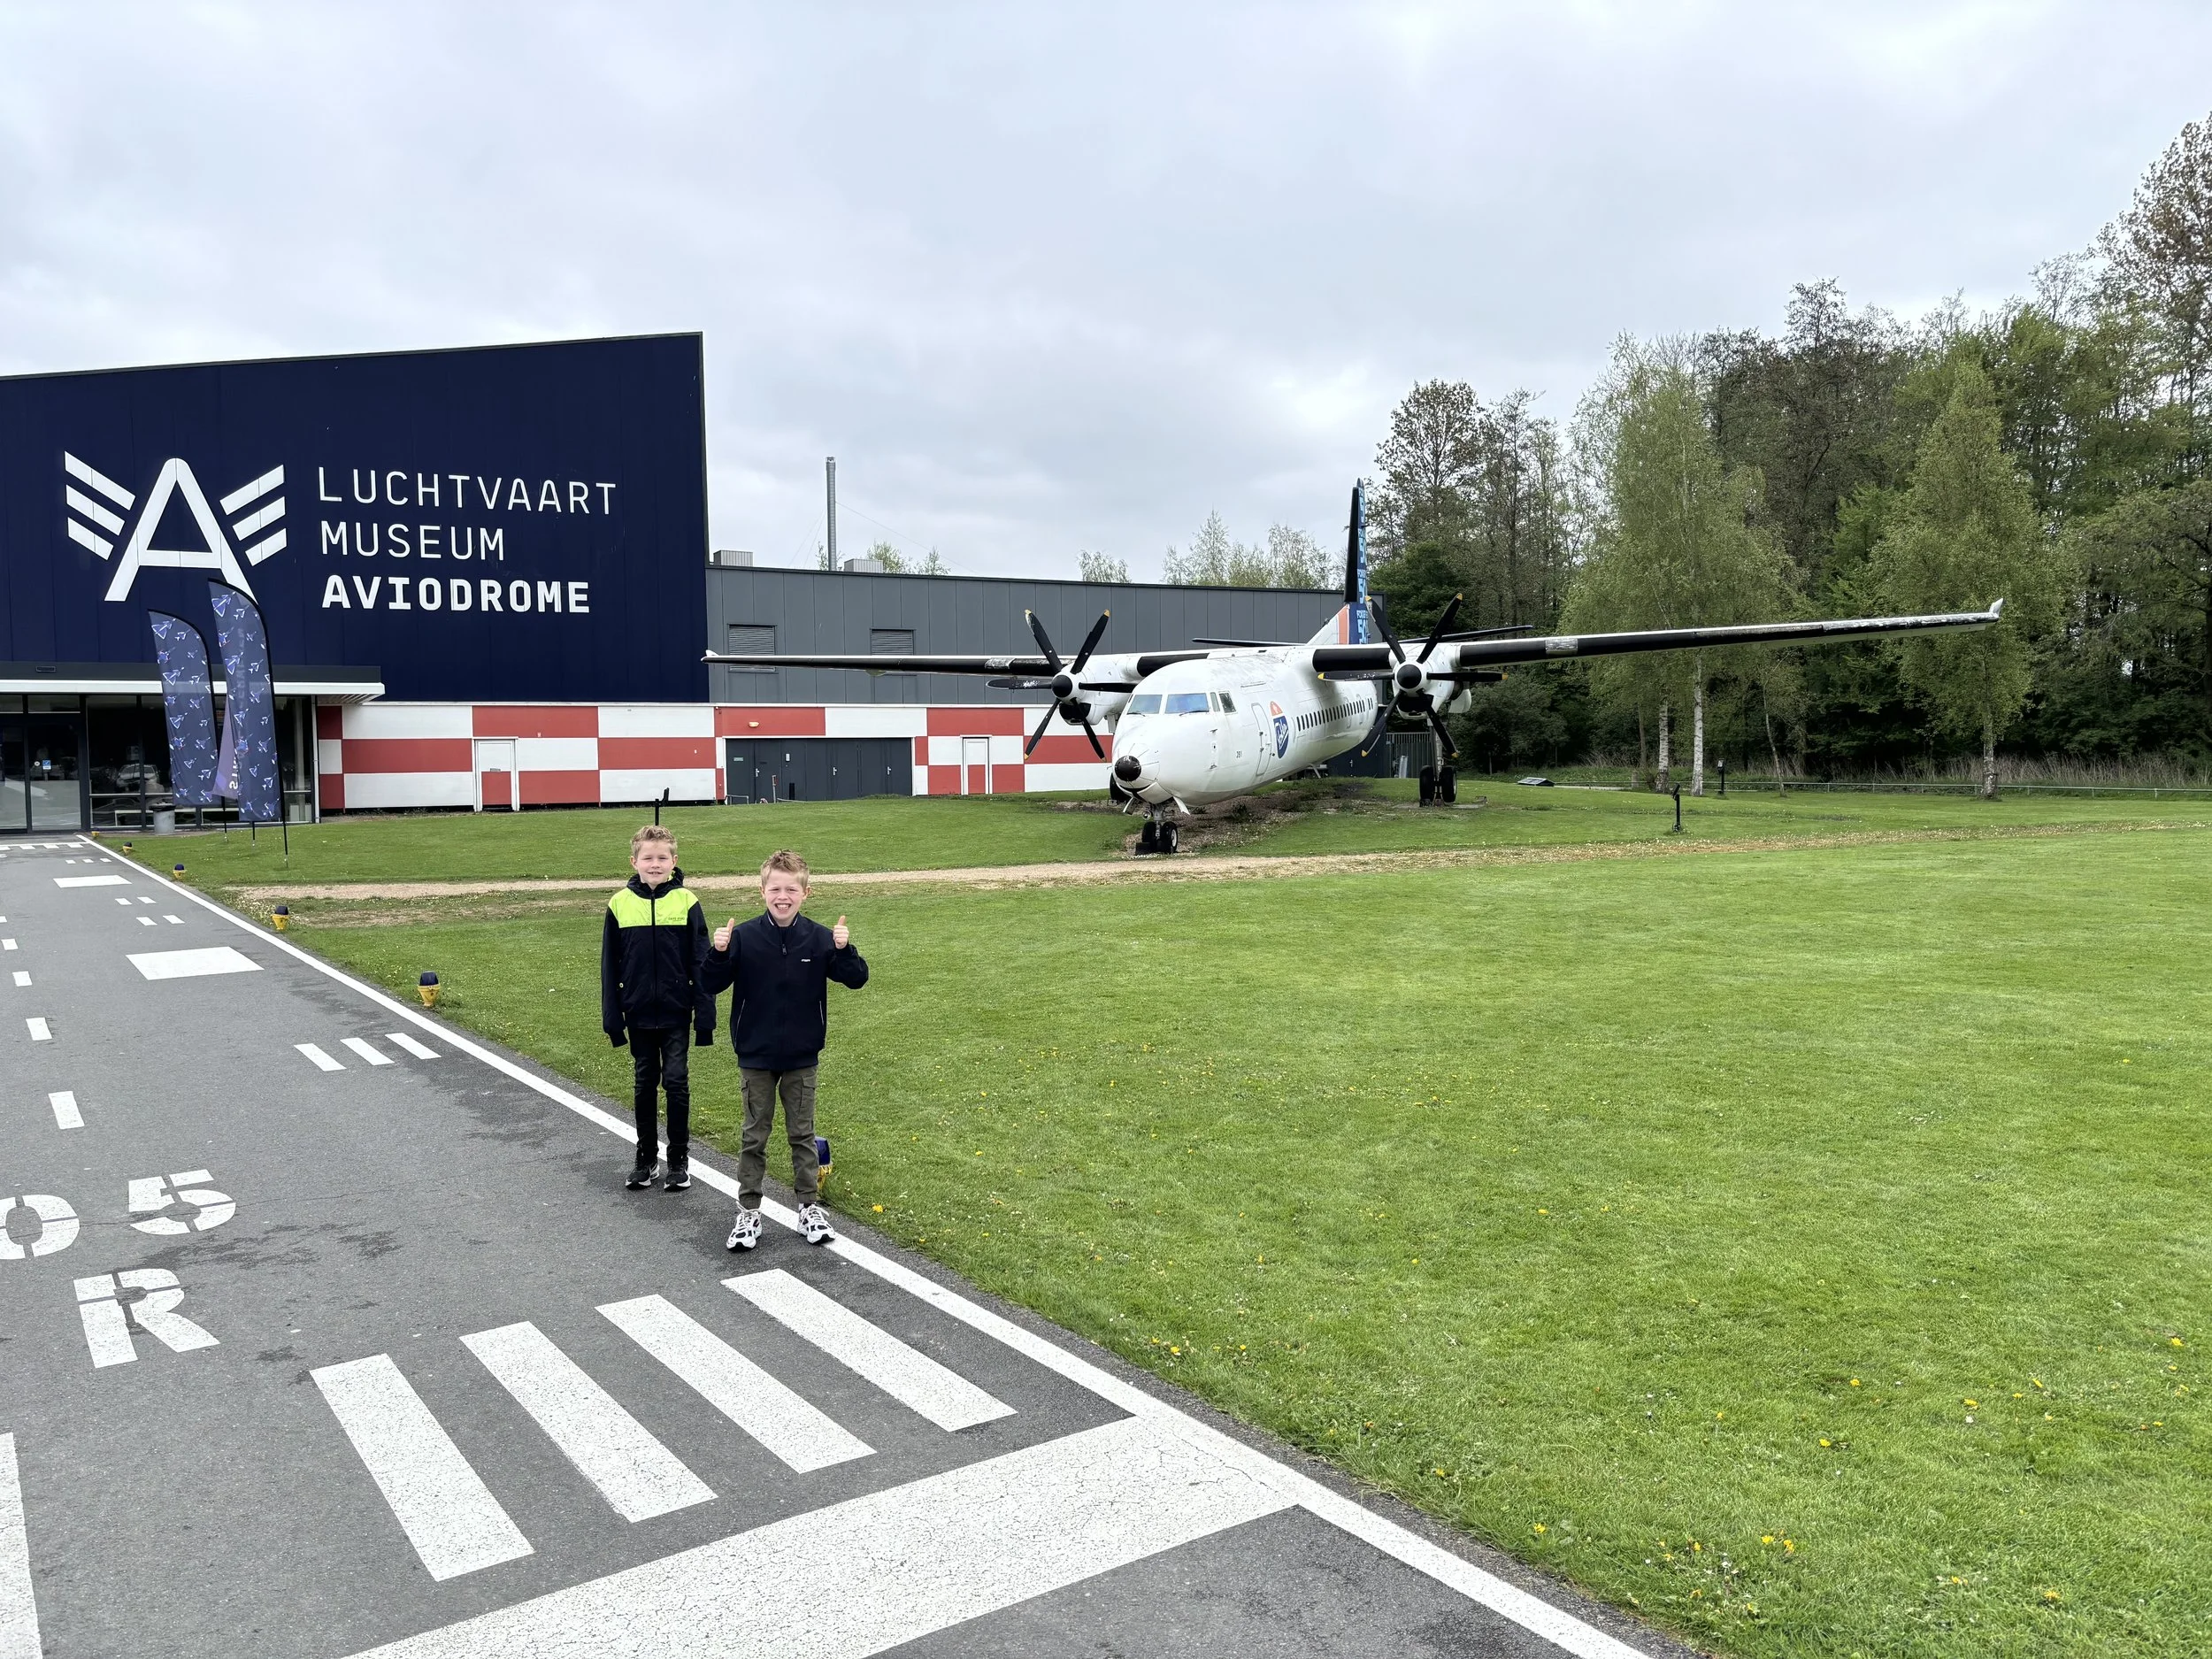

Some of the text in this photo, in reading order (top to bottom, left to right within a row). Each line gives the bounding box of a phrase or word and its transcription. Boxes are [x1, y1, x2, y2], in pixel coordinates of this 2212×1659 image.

[319, 466, 616, 514] LUCHTVAART
[321, 520, 503, 561] MUSEUM
[322, 574, 590, 613] AVIODROME
[73, 1268, 220, 1368] R
